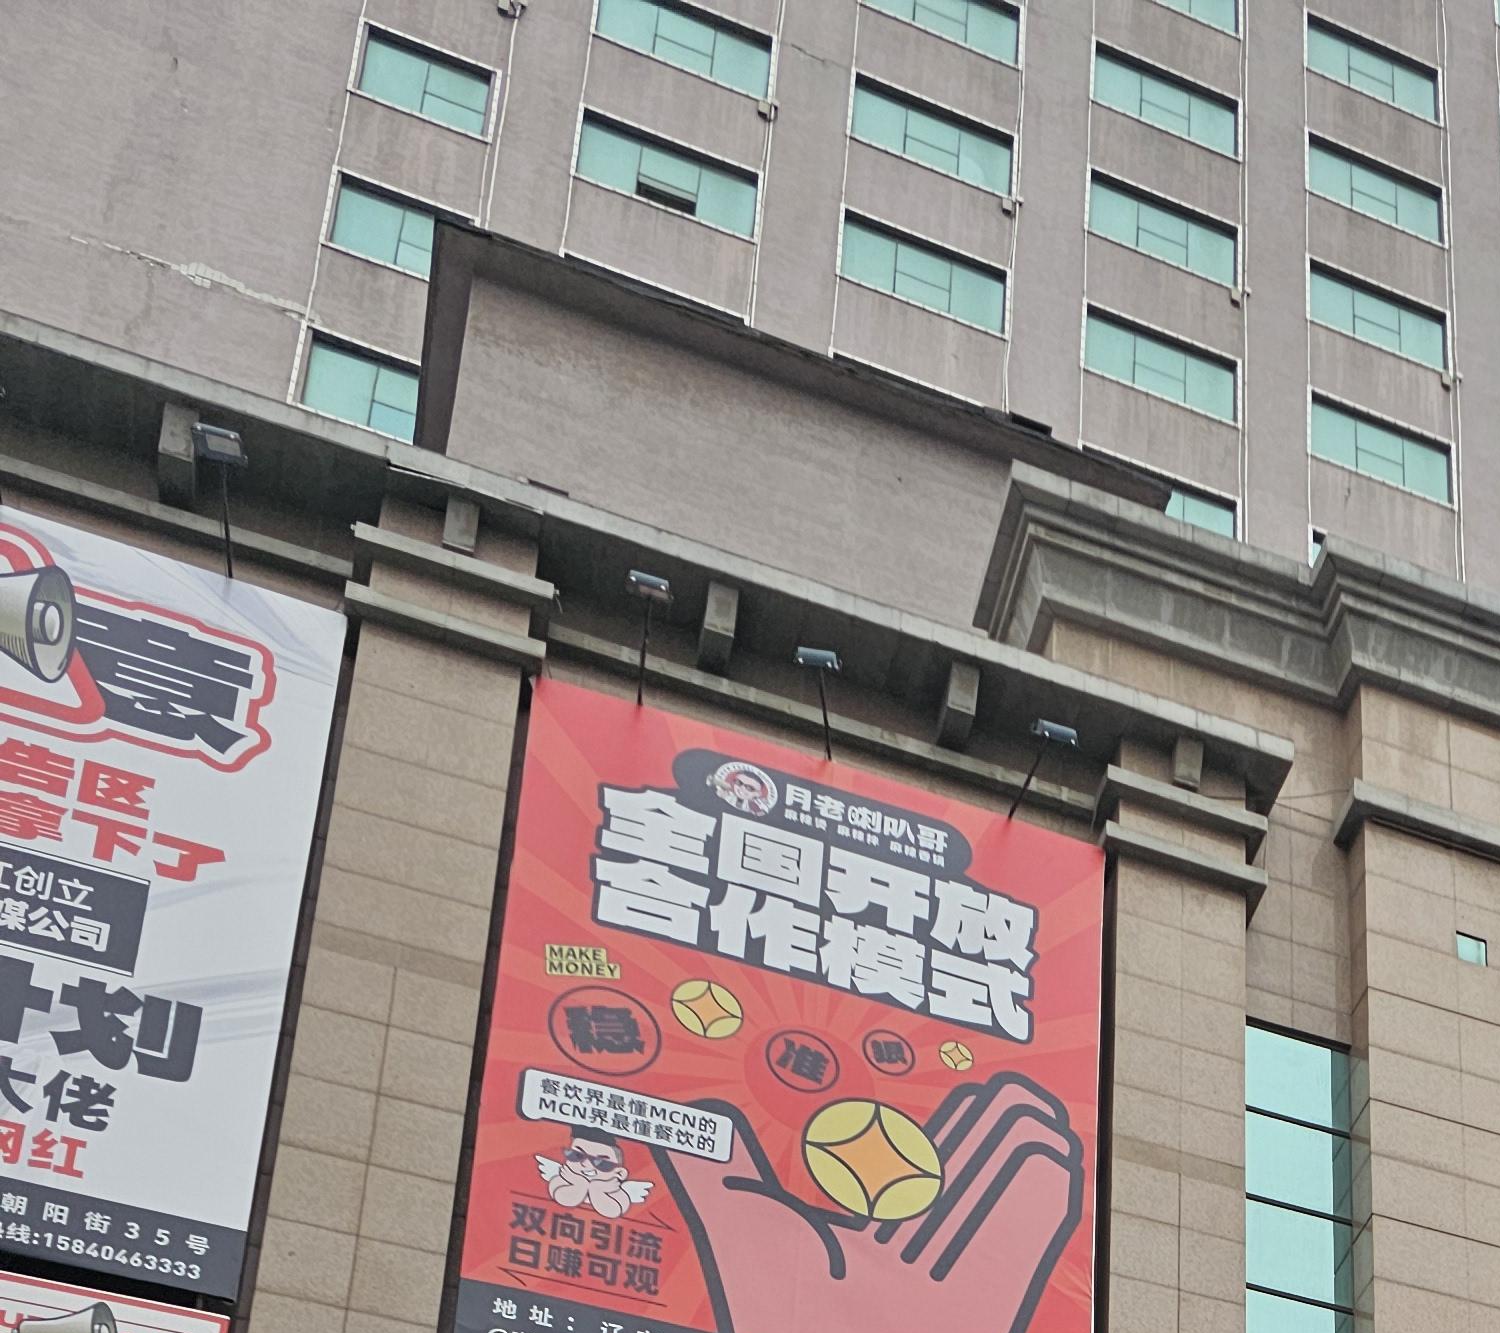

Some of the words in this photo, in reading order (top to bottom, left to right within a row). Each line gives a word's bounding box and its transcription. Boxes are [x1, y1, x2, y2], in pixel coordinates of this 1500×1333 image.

[602, 787, 1036, 970] 全国开放
[549, 945, 601, 961] MAKE
[549, 960, 617, 978] MONEY
[595, 857, 1030, 1040] 合作模式
[538, 1098, 715, 1153] MCN界最懂餐饮的
[540, 1078, 717, 1135] 餐饮界最懂MCN的
[510, 1202, 662, 1264] 双向引流
[508, 1235, 659, 1297] 日赚可观
